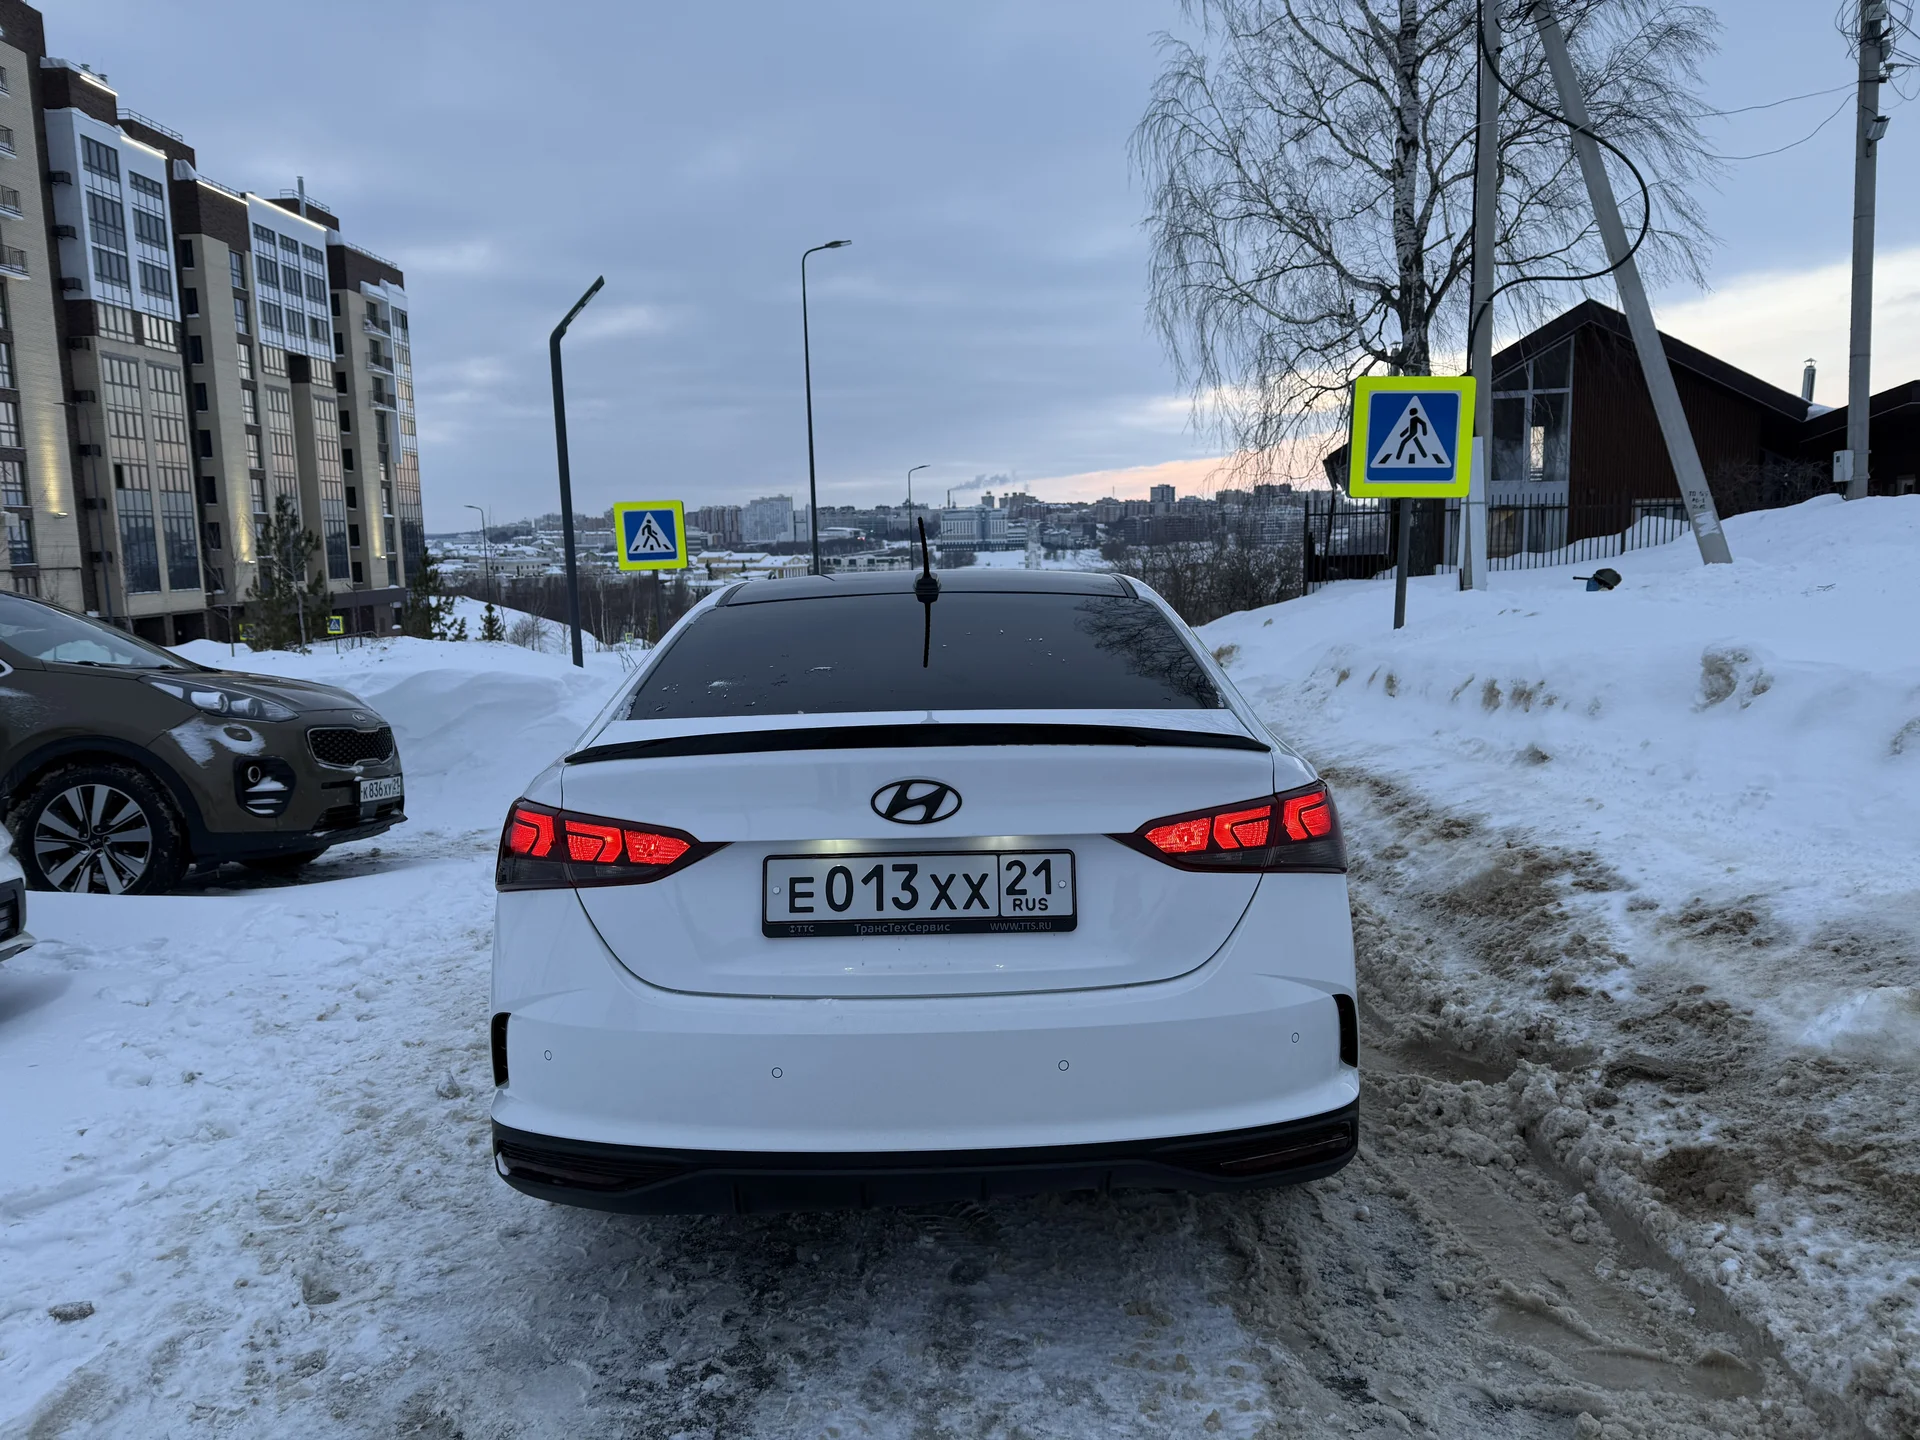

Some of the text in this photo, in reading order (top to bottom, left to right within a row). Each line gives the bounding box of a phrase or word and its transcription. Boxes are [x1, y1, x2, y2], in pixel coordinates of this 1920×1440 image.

[1005, 858, 1052, 896] 21
[1012, 898, 1049, 912] RUS
[854, 923, 950, 934] ТрансТехСервис
[990, 921, 1052, 931] WWW.TTS.RU
